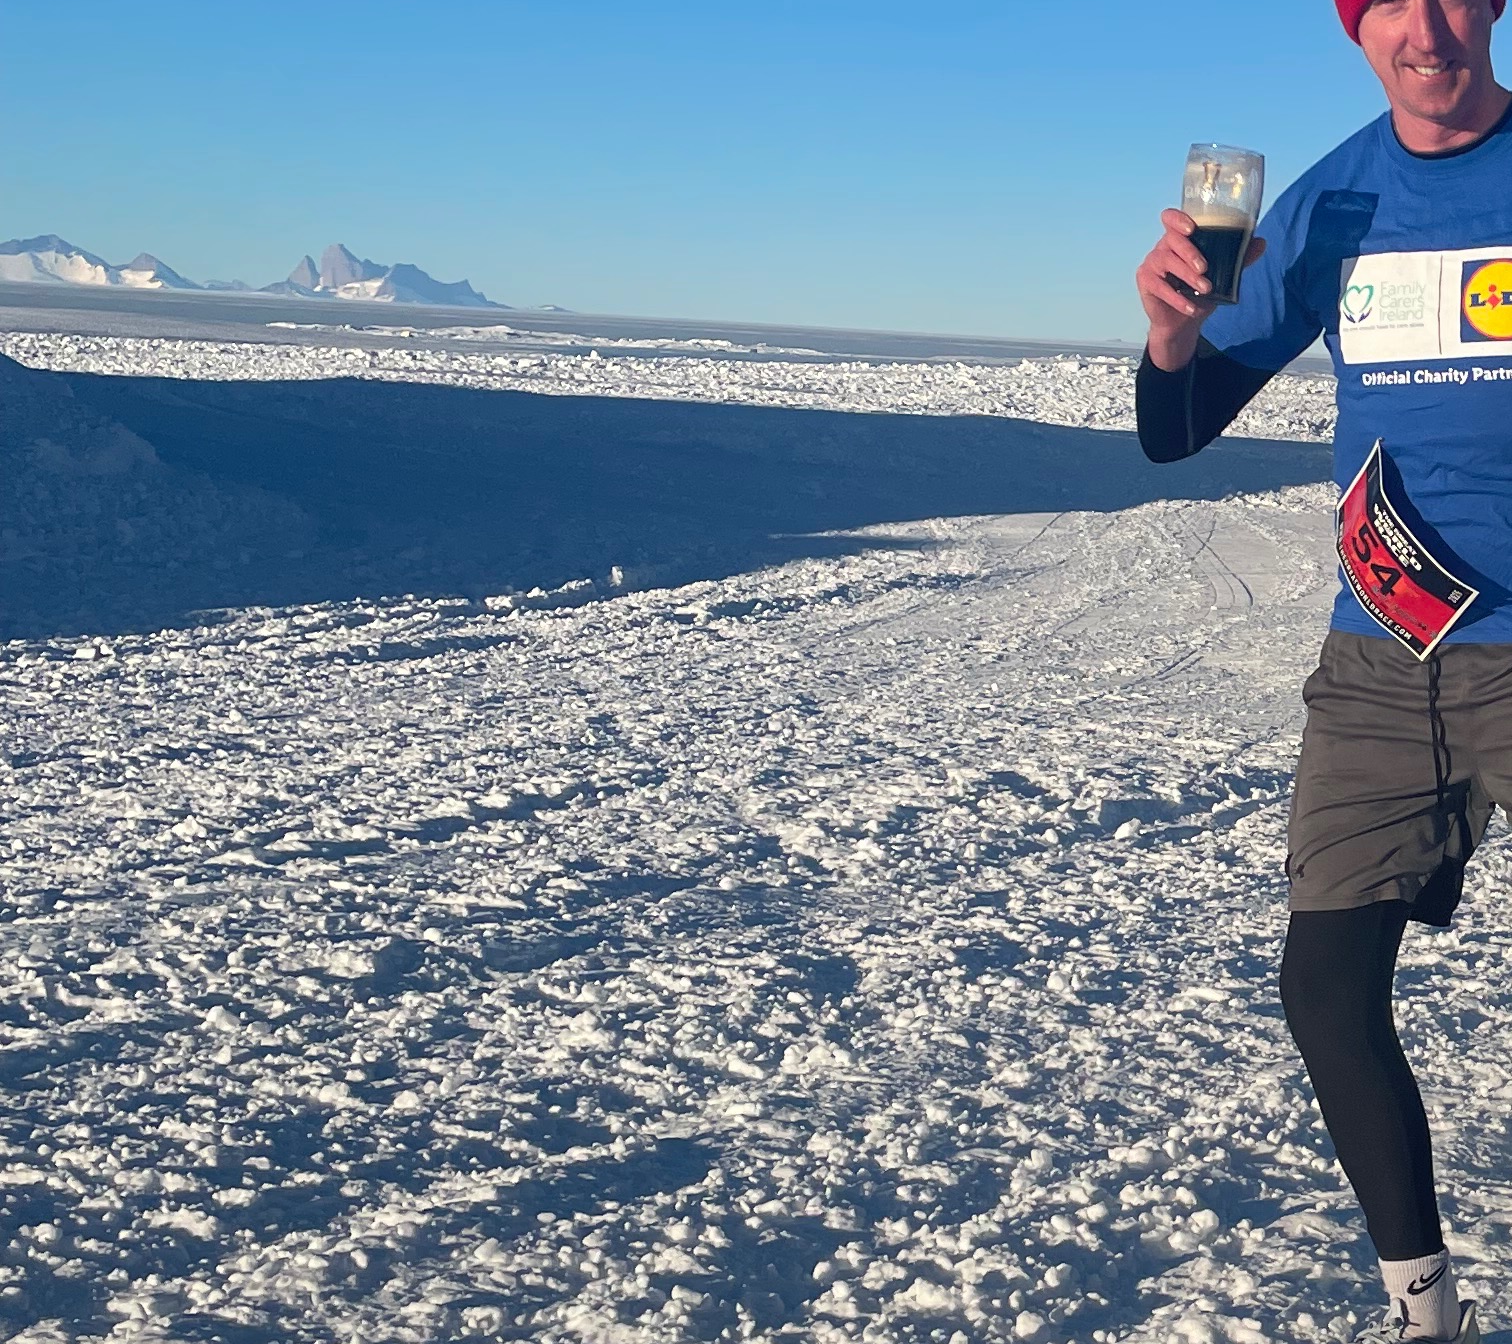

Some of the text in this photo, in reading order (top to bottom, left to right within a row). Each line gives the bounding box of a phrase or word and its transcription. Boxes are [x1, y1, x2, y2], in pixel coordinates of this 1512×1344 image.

[1380, 281, 1426, 296] Family
[1379, 294, 1425, 309] Carers
[1379, 307, 1424, 322] Ireland
[1362, 370, 1410, 387] Official
[1413, 367, 1469, 385] Charity
[1373, 502, 1423, 572] WORLD
[1374, 518, 1410, 568] RACE
[1352, 522, 1403, 596] 54
